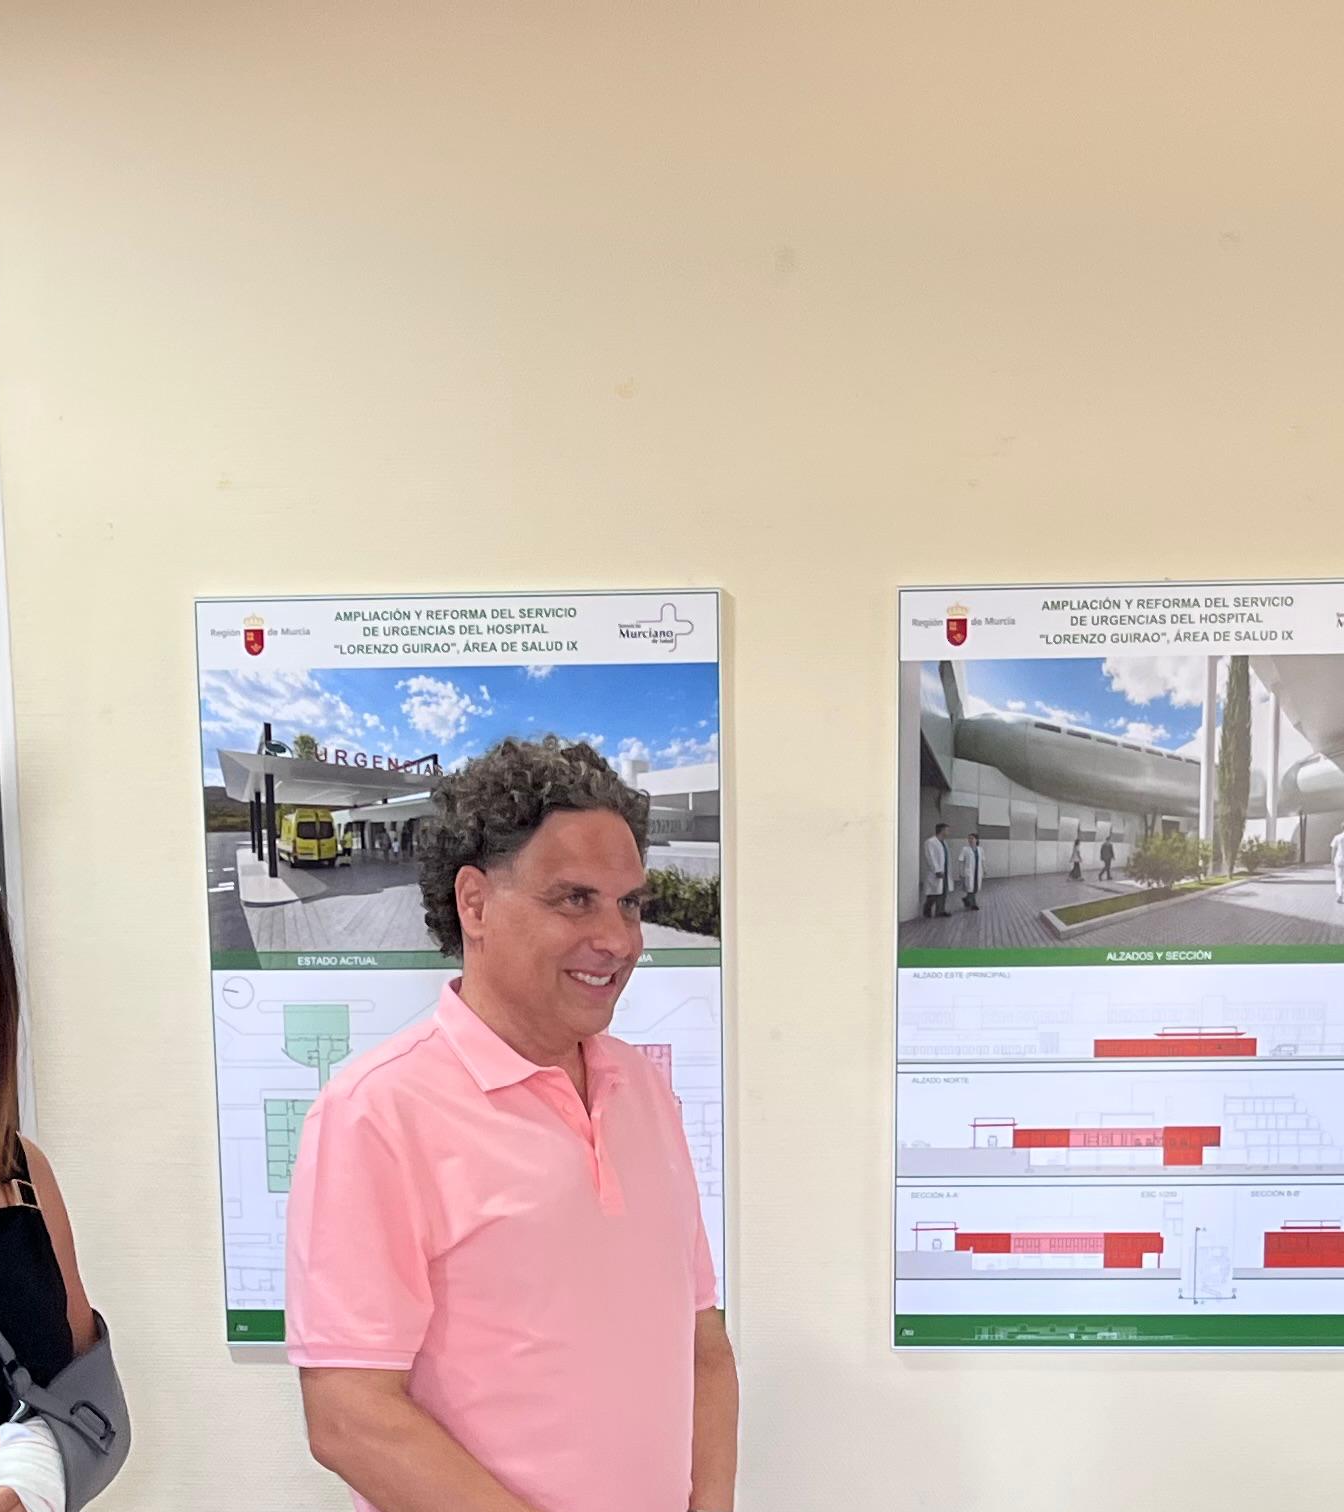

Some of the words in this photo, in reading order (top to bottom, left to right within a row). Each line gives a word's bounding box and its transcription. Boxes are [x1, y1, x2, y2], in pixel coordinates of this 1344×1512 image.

[1042, 597, 1121, 611] AMPLIACIÓN
[1124, 599, 1133, 609] Y
[1137, 598, 1200, 610] REFORMA
[1206, 597, 1229, 608] DEL
[1233, 596, 1294, 608] SERVICIO
[334, 609, 411, 622] AMPLIACIÓN
[414, 610, 422, 621] Y
[426, 608, 487, 620] REFORMA
[491, 608, 514, 619] DEL
[518, 607, 576, 618] SERVICIO
[1070, 616, 1087, 626] DE
[1091, 613, 1166, 626] URGENCIAS
[1170, 613, 1194, 625] DEL
[1199, 612, 1263, 624] HOSPITAL
[985, 617, 1016, 627] Murcia
[281, 626, 311, 637] Murcia
[362, 626, 379, 637] DE
[383, 624, 455, 637] URGENCIAS
[459, 624, 483, 635] DEL
[487, 623, 548, 634] HOSPITAL
[618, 628, 673, 639] Murciano
[1040, 633, 1106, 645] "LORENZO
[1174, 629, 1210, 642] ÁREA
[1213, 631, 1230, 642] DE
[1234, 630, 1277, 642] SALUD
[1282, 630, 1294, 641] IX
[334, 643, 398, 655] "LORENZO
[463, 640, 496, 652] ÁREA
[501, 641, 517, 652] DE
[521, 641, 562, 652] SALUD
[567, 640, 578, 651] IX
[297, 955, 337, 966] ESTADO
[340, 955, 378, 965] ACTUAL
[1106, 951, 1155, 961] ALZADOS
[1155, 951, 1163, 961] Y
[1165, 949, 1212, 961] SECCIÓN
[913, 971, 942, 979] ALZADO
